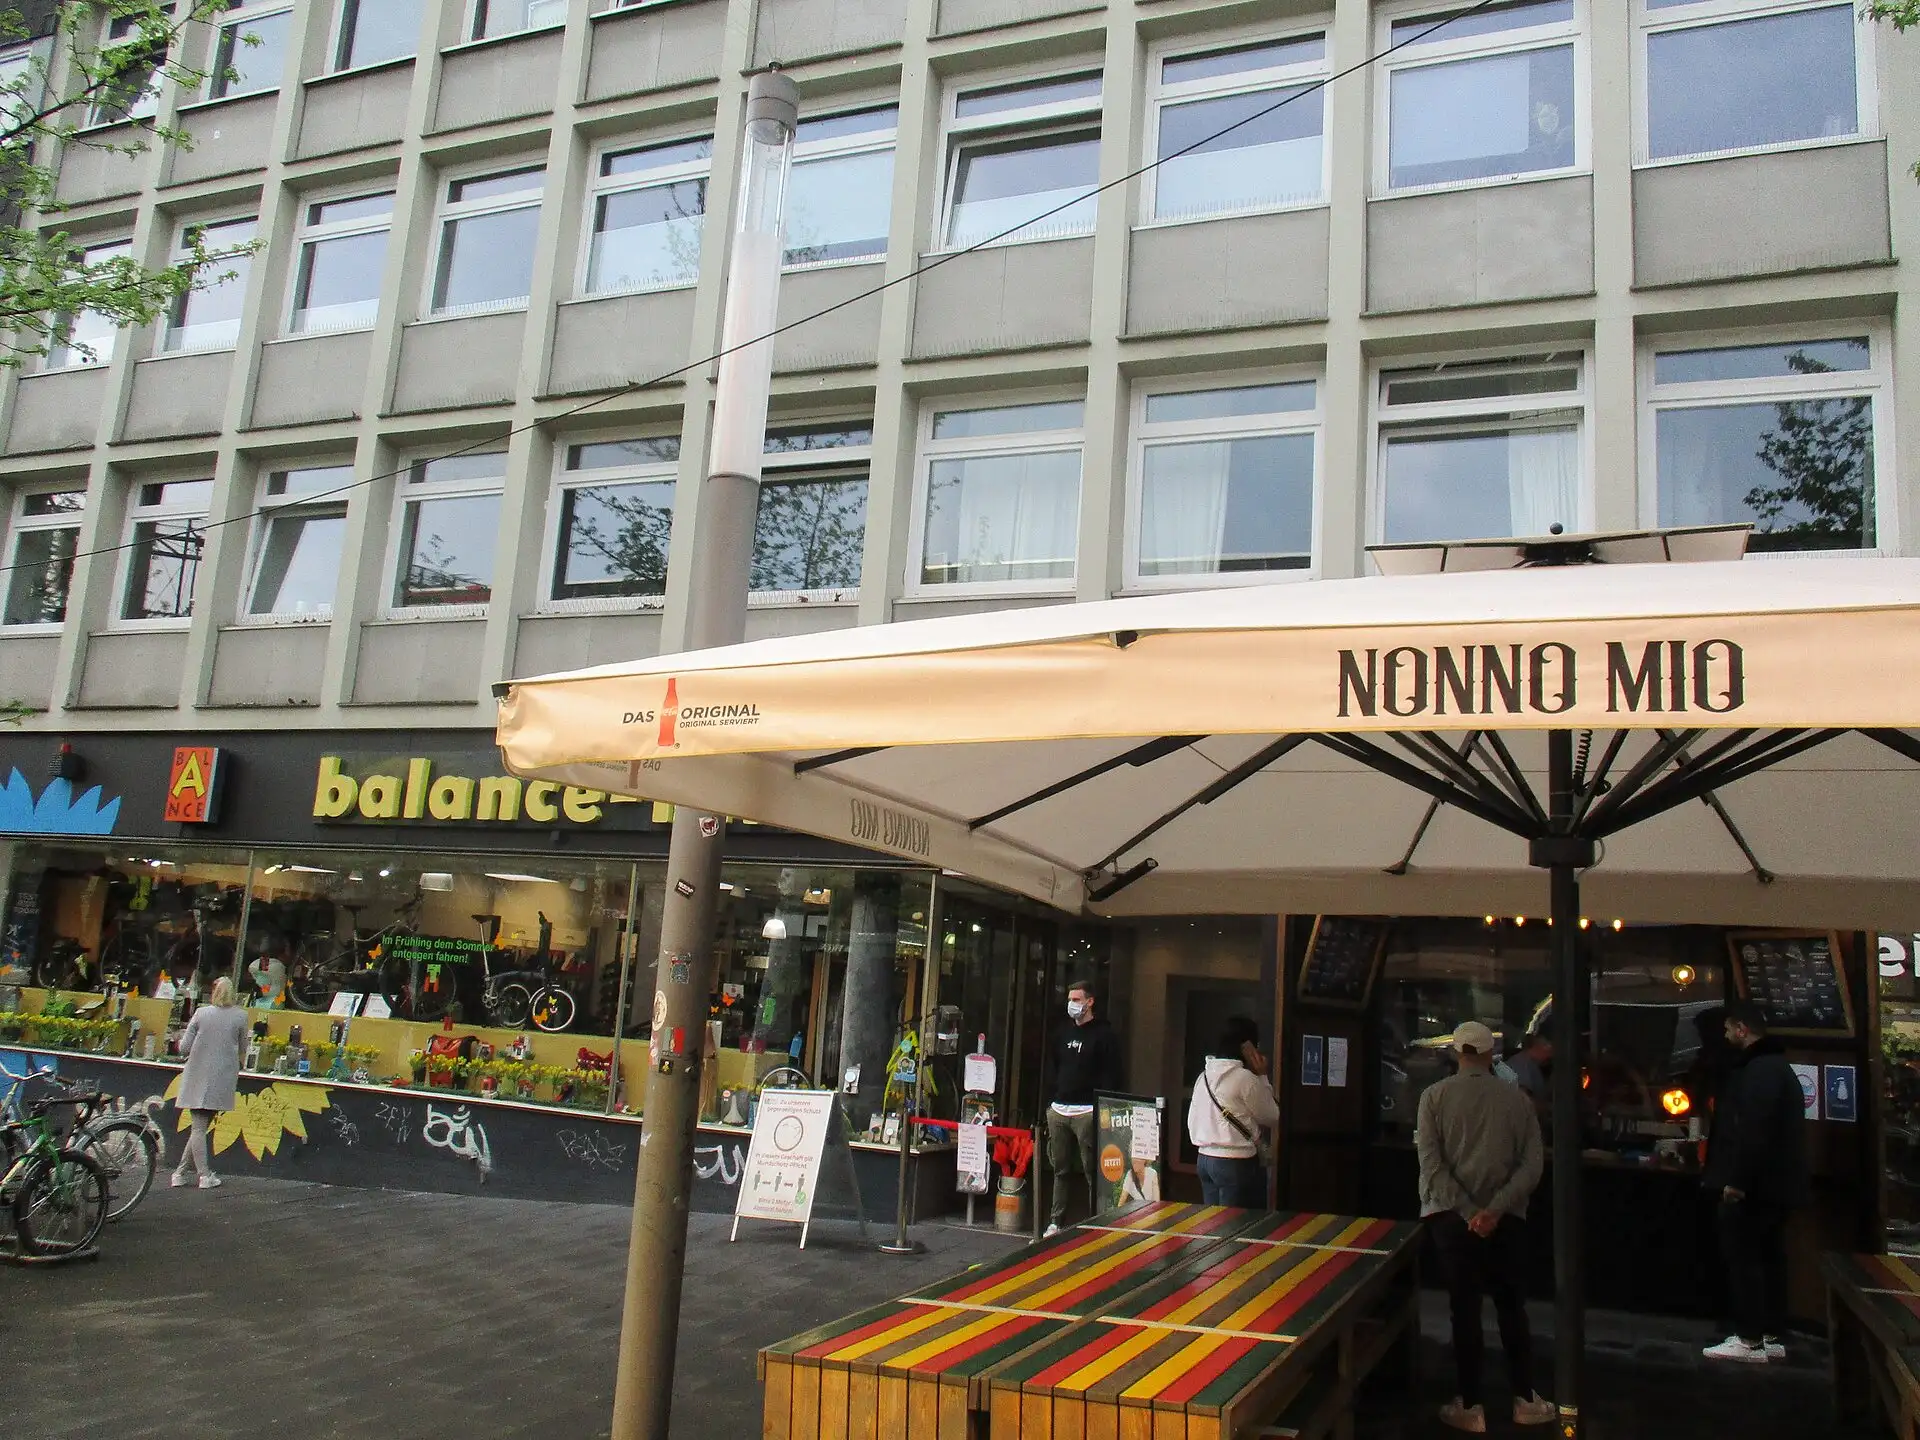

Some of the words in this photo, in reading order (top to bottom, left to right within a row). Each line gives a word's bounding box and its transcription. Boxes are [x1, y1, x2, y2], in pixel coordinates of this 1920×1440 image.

[1337, 642, 1577, 717] NONNO
[1606, 638, 1746, 713] MIO
[622, 710, 655, 724] DAS
[680, 703, 761, 719] ORIGINAL
[679, 719, 717, 729] ORIGINAL
[719, 717, 760, 727] SERVIERT
[382, 934, 393, 945] Im
[395, 935, 432, 950] Frühling
[434, 938, 455, 950] dem
[456, 940, 497, 952] Sommer
[392, 948, 434, 962] entgegen
[436, 951, 469, 964] fahren!
